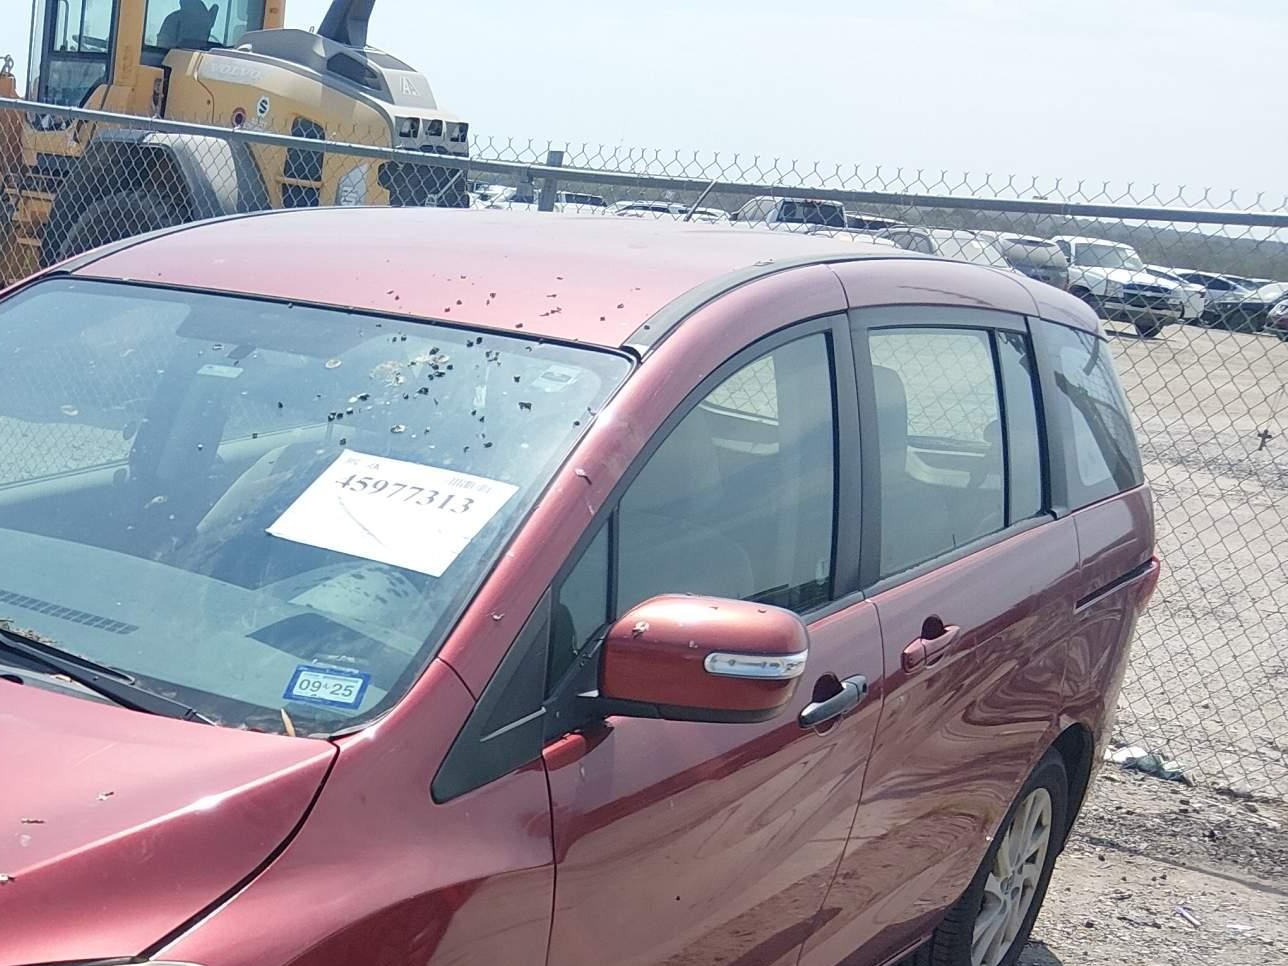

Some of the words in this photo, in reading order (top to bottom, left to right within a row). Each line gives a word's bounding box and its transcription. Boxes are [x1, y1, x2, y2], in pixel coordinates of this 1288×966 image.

[334, 474, 476, 513] 45977313
[299, 679, 322, 692] 09
[329, 683, 355, 698] 25
